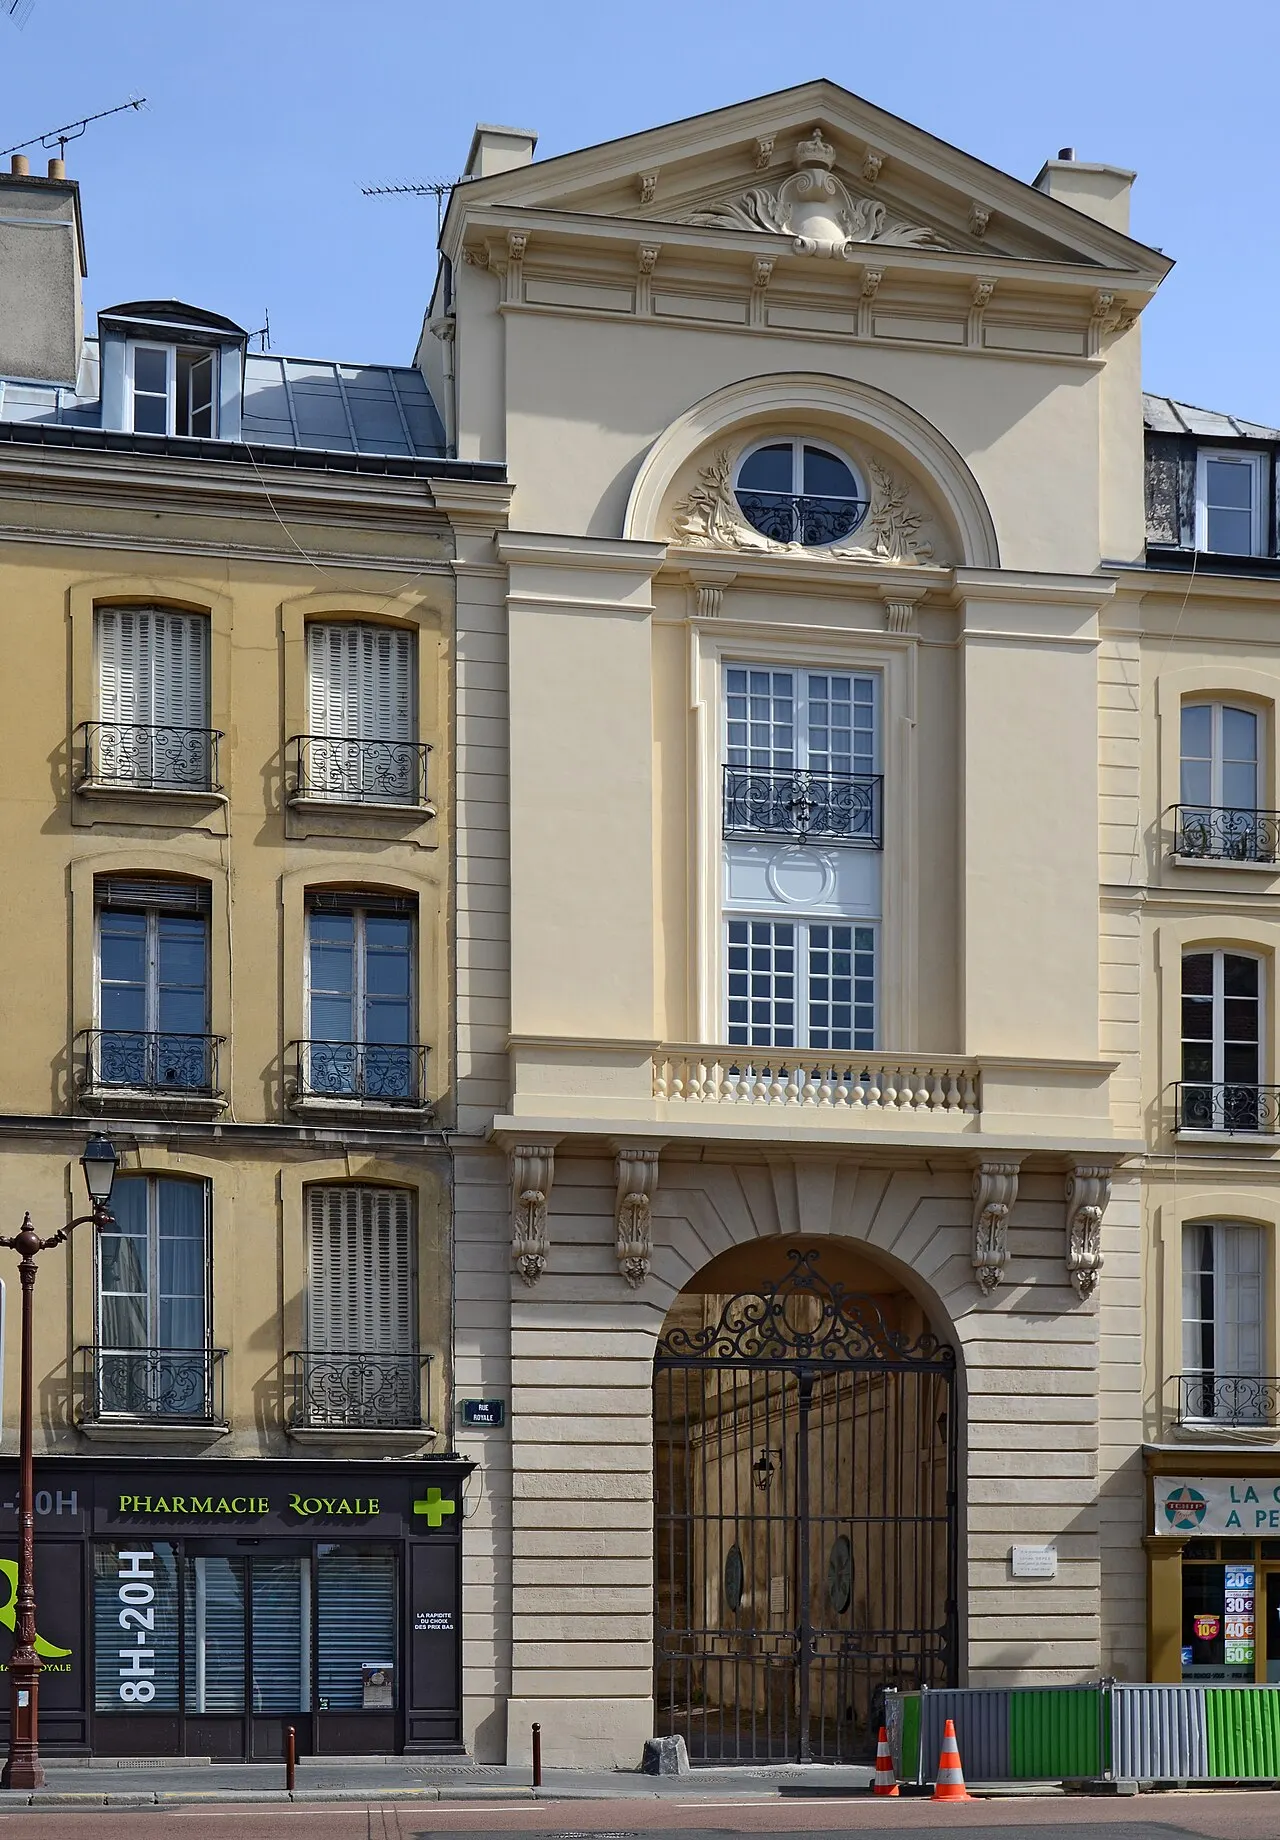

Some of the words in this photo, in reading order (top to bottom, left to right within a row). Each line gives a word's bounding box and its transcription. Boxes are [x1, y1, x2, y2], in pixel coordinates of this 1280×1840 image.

[473, 1414, 494, 1422] ROYALE
[1230, 1485, 1260, 1504] LA
[119, 1495, 270, 1514] PHARMACIE
[288, 1493, 380, 1516] ROYALE
[1225, 1509, 1241, 1528] A
[1226, 1572, 1253, 1587] 20€
[1226, 1598, 1253, 1613] 30€
[118, 1551, 156, 1703] 8H-20H
[1197, 1624, 1217, 1637] 10€
[1226, 1623, 1253, 1637] 40€
[1226, 1648, 1253, 1662] 50€
[40, 1664, 72, 1672] OYALE
